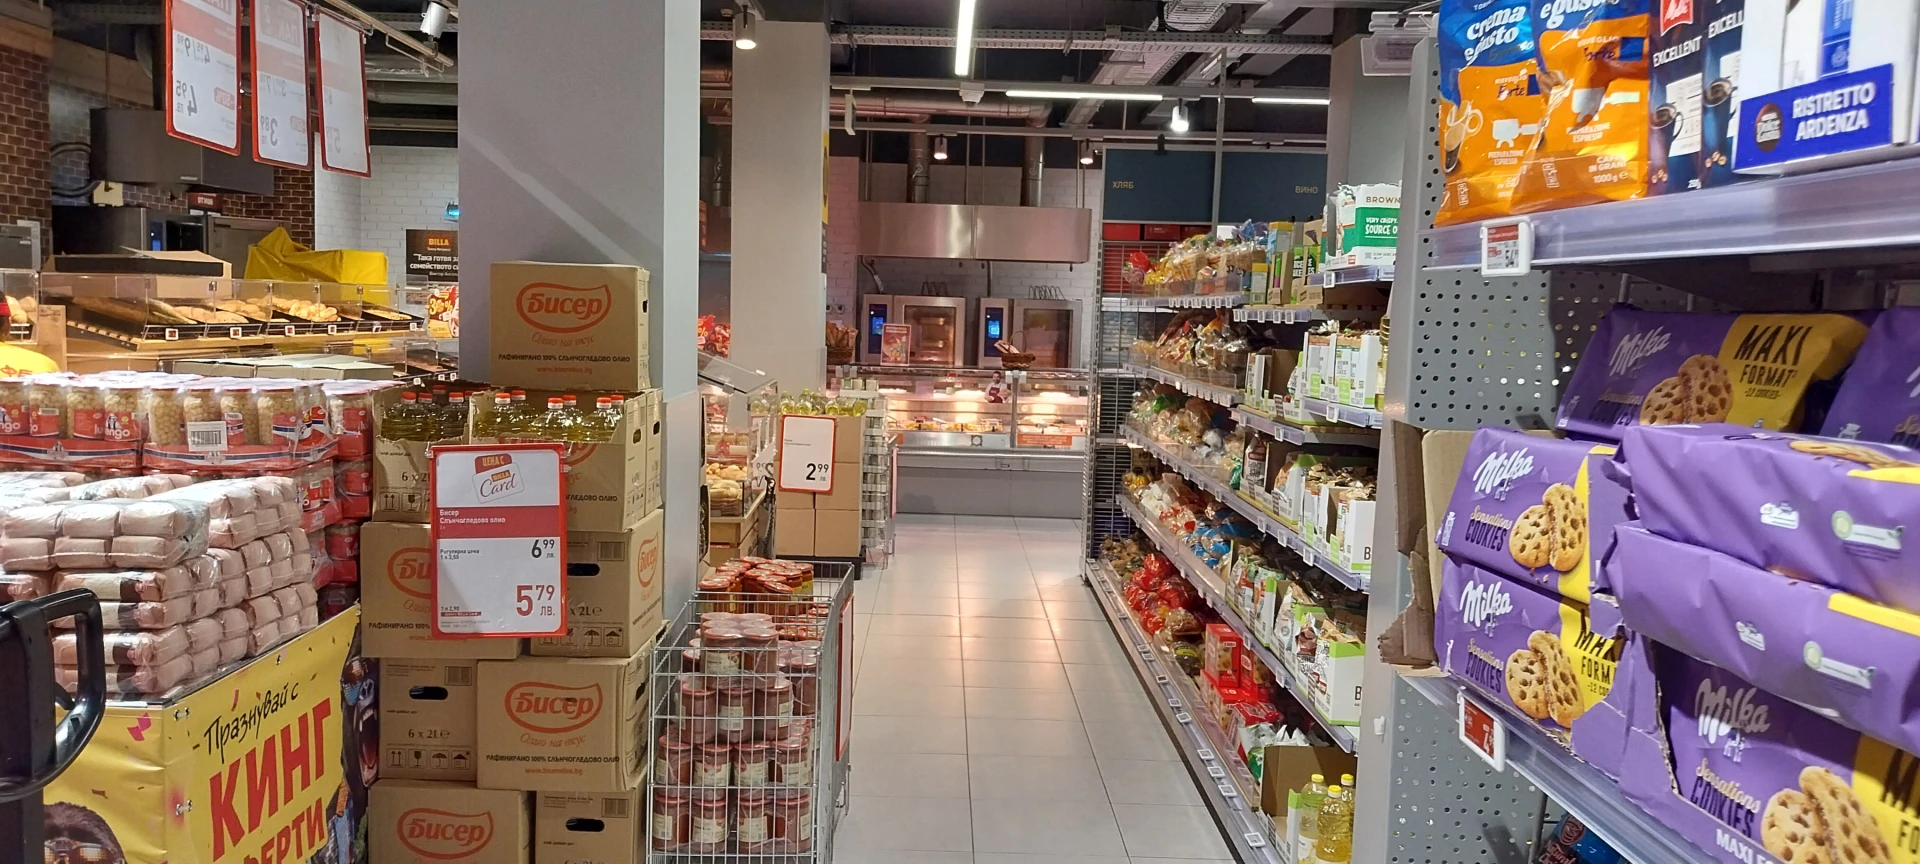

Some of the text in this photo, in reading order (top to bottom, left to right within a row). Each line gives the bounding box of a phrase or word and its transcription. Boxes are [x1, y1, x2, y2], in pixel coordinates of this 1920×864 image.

[1467, 6, 1526, 41] crema
[1653, 36, 1703, 67] EXCELLENT
[1793, 82, 1877, 119] RISTRETTO
[1795, 109, 1870, 142] ARDENZA
[1113, 181, 1134, 189] ХЛЯБ
[1295, 186, 1318, 194] ВИНО
[429, 238, 449, 246] BILLA
[1366, 224, 1391, 235] SOURCE
[527, 293, 603, 320] Бисер
[1609, 326, 1672, 376] Milka
[1733, 325, 1813, 366] MAXI
[402, 472, 408, 482] 6
[483, 457, 500, 466] ЦЕНА
[1473, 447, 1534, 494] Milka
[480, 473, 518, 498] Card
[1470, 505, 1513, 530] Sensations
[1465, 519, 1508, 552] COOKIES
[1460, 580, 1513, 627] Milka
[1468, 638, 1504, 671] Sensations
[1466, 652, 1502, 694] COOKIES
[515, 693, 594, 720] Бисер
[1695, 678, 1771, 744] Milka
[204, 683, 299, 764] Празнувай с
[408, 729, 415, 738] 6
[520, 733, 545, 747] Олио
[550, 740, 562, 748] на
[210, 697, 331, 862] КИНГ
[1696, 758, 1761, 814] Sensations
[1690, 775, 1756, 839] COOKIES
[406, 818, 485, 847] Бисер
[1717, 828, 1754, 864] MAXI
